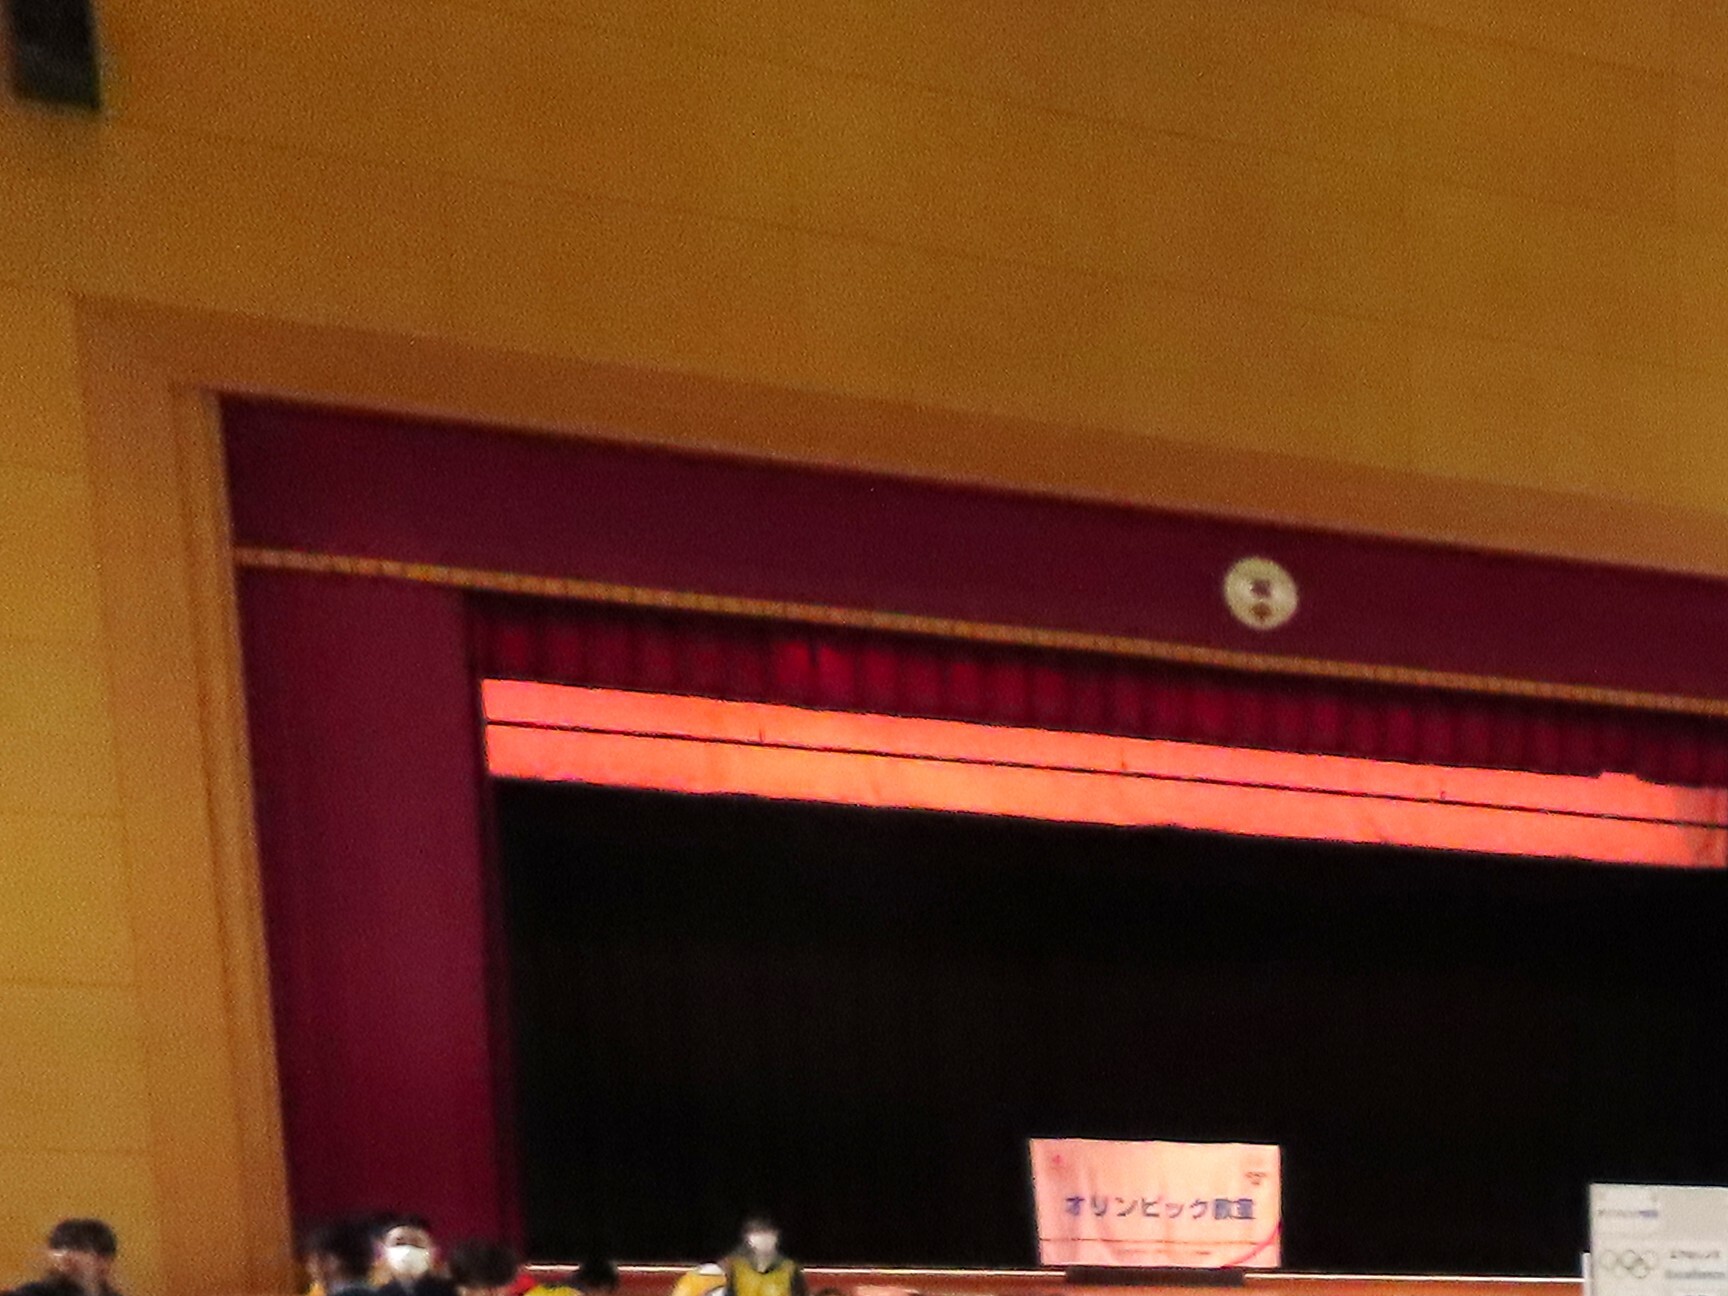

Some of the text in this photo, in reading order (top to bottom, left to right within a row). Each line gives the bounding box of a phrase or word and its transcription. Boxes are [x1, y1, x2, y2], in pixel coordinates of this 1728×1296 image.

[1065, 1195, 1256, 1219] オリンピック教室
